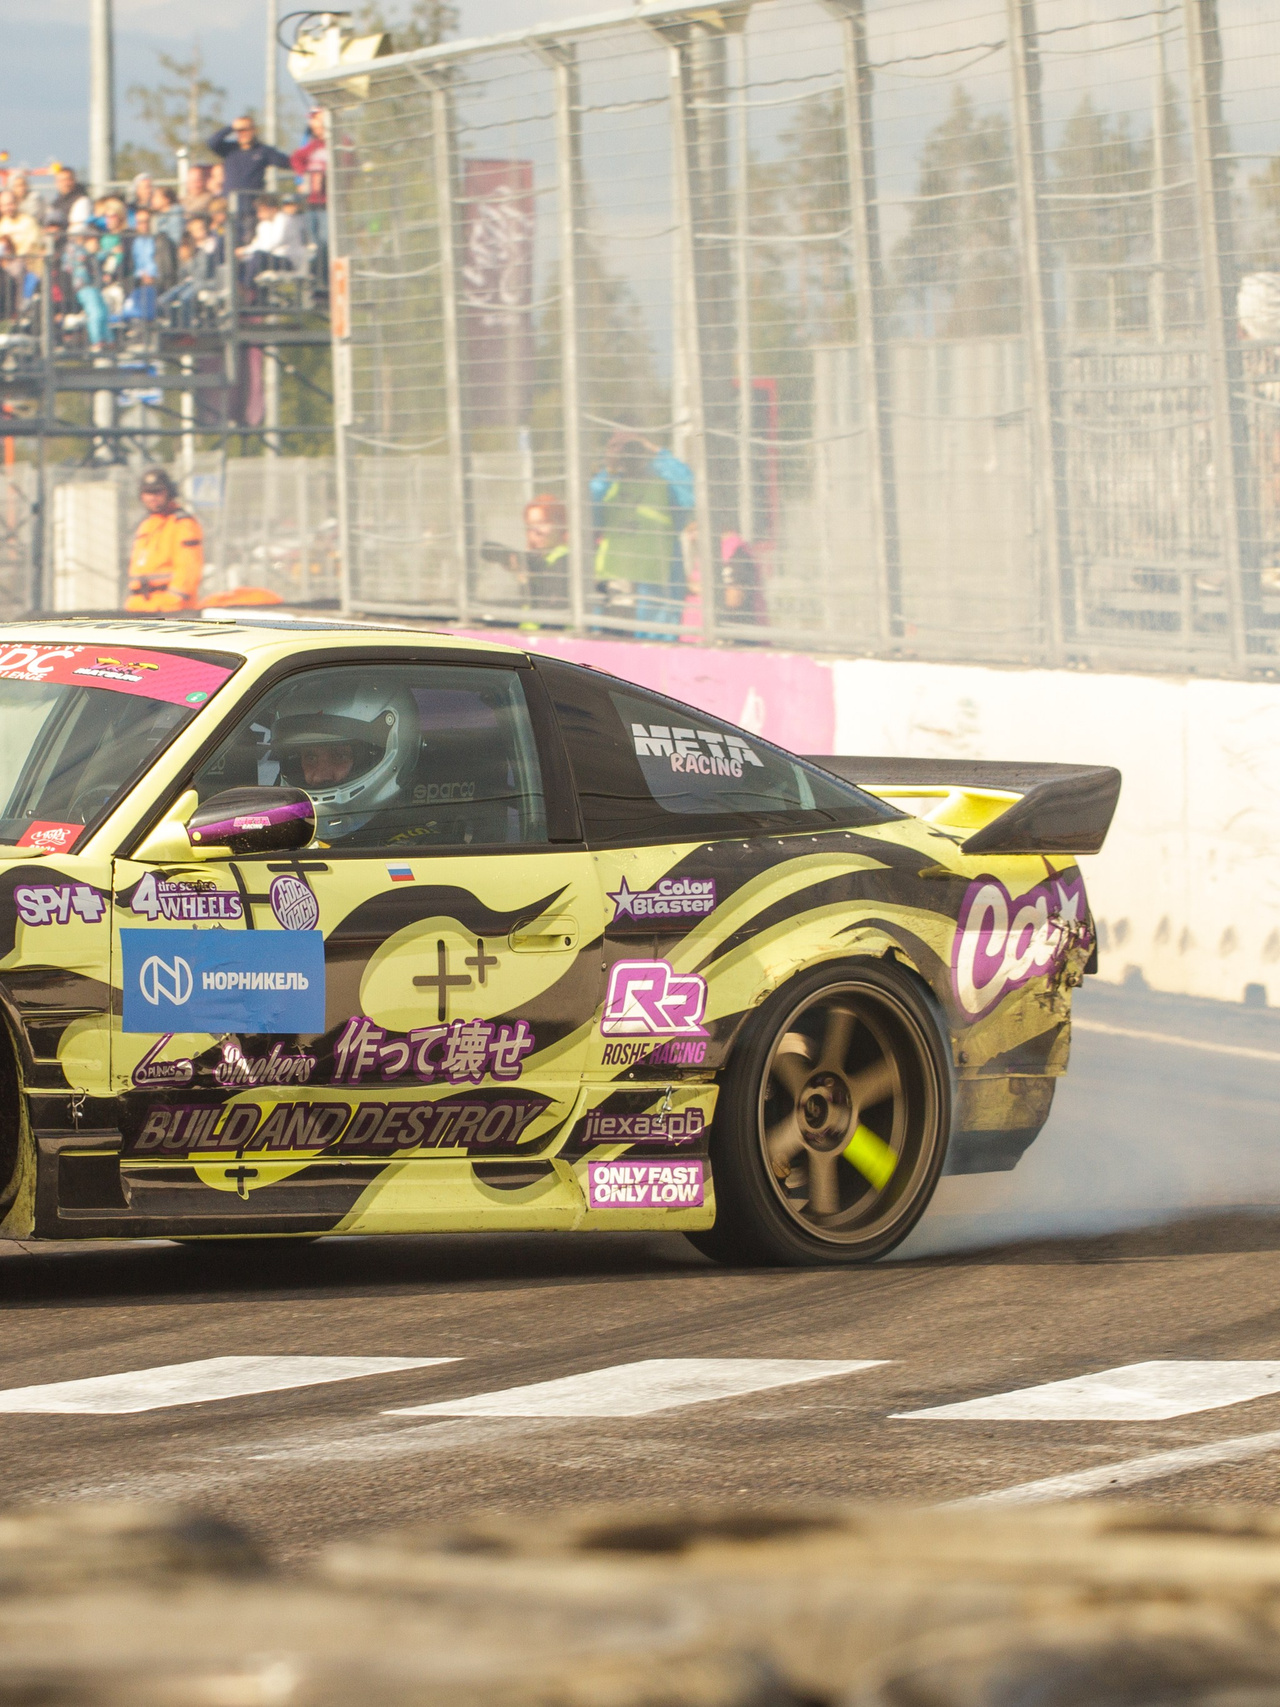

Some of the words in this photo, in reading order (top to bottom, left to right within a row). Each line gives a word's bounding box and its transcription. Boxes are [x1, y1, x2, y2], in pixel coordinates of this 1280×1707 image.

[670, 752, 743, 778] RACING
[158, 881, 177, 892] tire
[658, 879, 713, 896] Color
[159, 896, 242, 918] WHEELS
[632, 898, 714, 915] Blaster
[202, 971, 310, 990] НОРНИКЕЛЬ
[336, 1019, 530, 1080] 作って壊せ
[601, 1043, 649, 1065] ROSHE
[649, 1041, 707, 1064] RACING
[148, 1067, 176, 1078] PUNKS
[214, 1044, 317, 1084] Smokers
[133, 1106, 258, 1150] BUILD
[252, 1104, 348, 1148] AND
[343, 1103, 544, 1147] DESTROY
[593, 1166, 647, 1185] ONLY
[647, 1166, 699, 1185] FAST
[594, 1184, 649, 1203] ONLY
[651, 1184, 700, 1203] LOW
